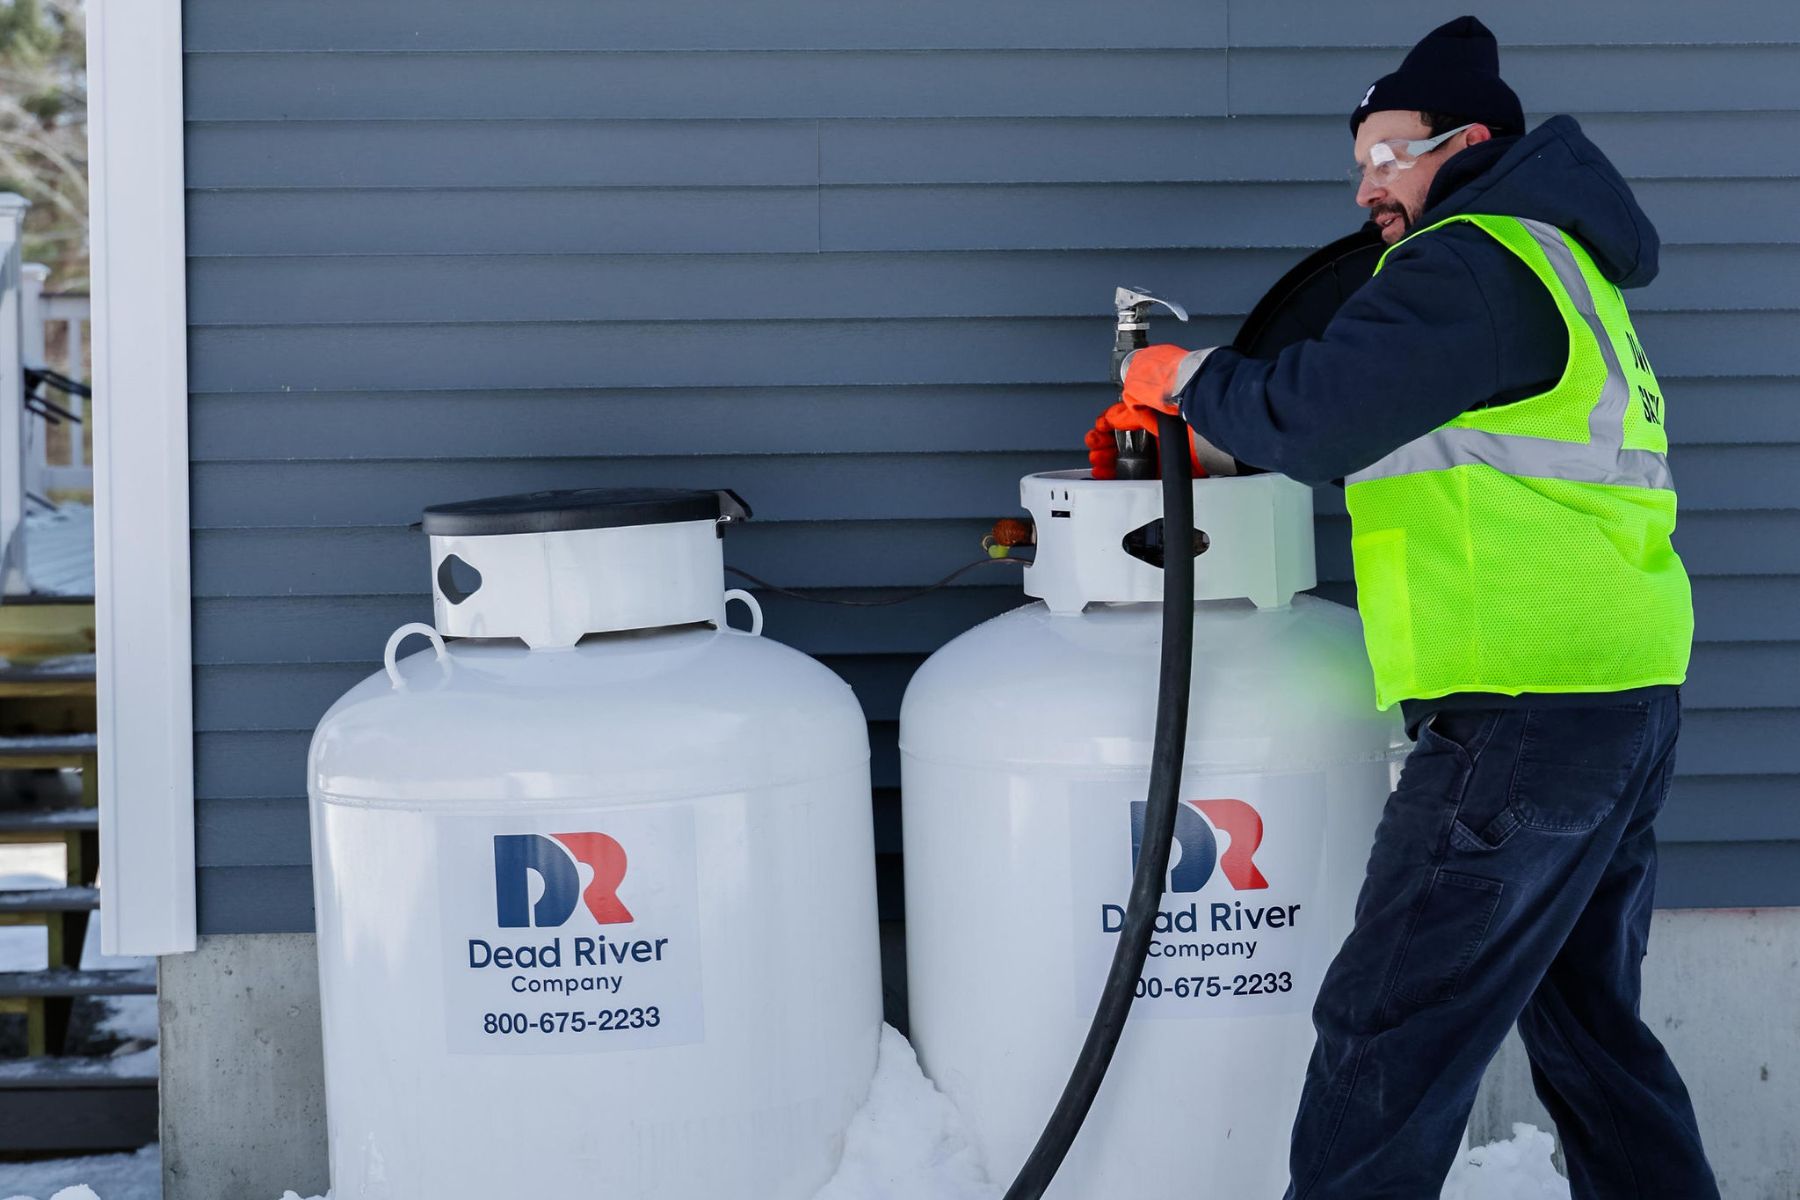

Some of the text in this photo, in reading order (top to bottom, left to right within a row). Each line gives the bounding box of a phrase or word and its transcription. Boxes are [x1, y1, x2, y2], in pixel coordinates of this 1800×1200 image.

[1102, 901, 1301, 933] Dad River
[468, 935, 669, 969] Dead River
[1147, 941, 1257, 961] Company
[511, 975, 623, 996] Company
[1133, 971, 1293, 999] 00-675-2233
[484, 1006, 661, 1035] 800-675-2233
